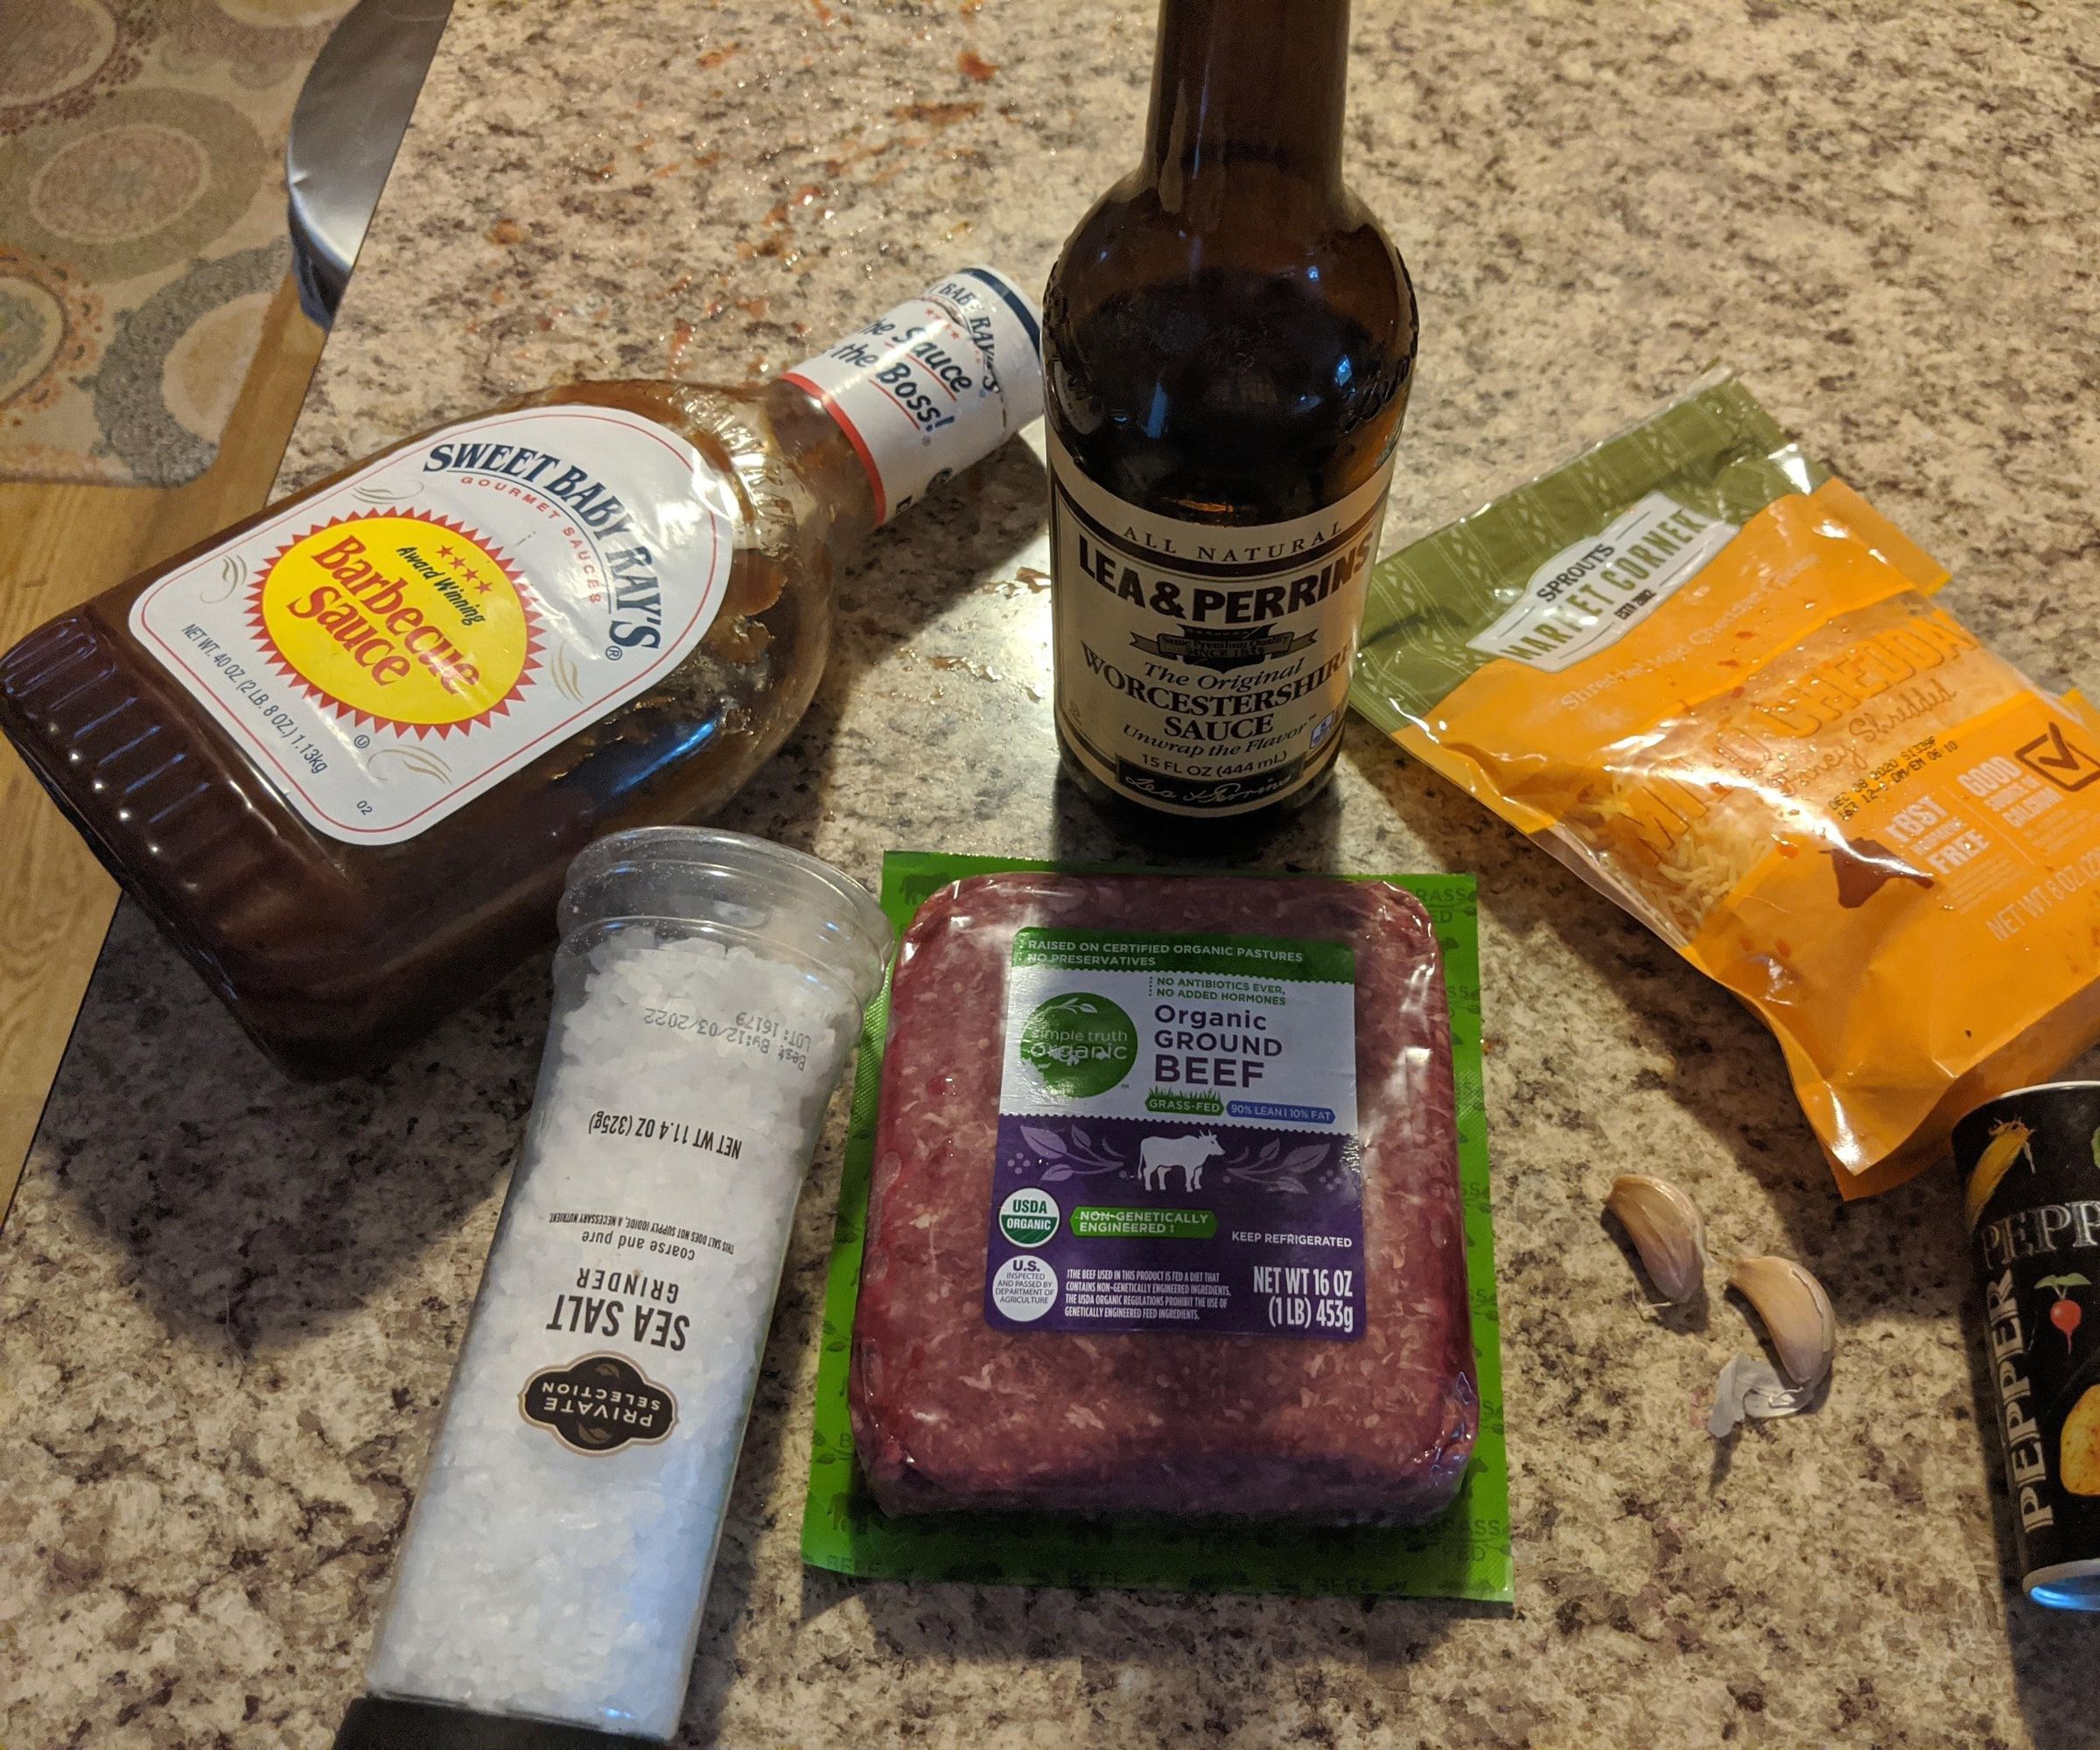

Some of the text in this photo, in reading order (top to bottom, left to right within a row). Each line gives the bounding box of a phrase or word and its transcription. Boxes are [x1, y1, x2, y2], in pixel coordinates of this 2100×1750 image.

[832, 343, 878, 368] the
[892, 326, 972, 393] Sauce
[424, 443, 662, 649] SWEET BABY RAY'S
[460, 476, 602, 604] GOURMET SAUCES
[1124, 521, 1341, 562] ALL NATURAL
[1600, 509, 1709, 592] CORNER
[1536, 542, 1614, 602] SPROUTS
[396, 546, 486, 626] Award Winning
[311, 535, 480, 695] Barbecue
[287, 586, 411, 688] Sauce
[1144, 658, 1306, 693] The Original
[181, 623, 328, 774] NET WT. 40 OZ. (2 LB. 8 OZ.) 1.13kg
[1848, 678, 1957, 743] Shredded
[1123, 723, 1204, 758] Unwrap
[1208, 743, 1240, 757] the
[1245, 724, 1306, 752] Flavor
[1164, 713, 1275, 742] SAUCE
[1141, 751, 1287, 778] 15 FL OZ (444 mL)
[1956, 756, 2023, 797] GOOD
[355, 799, 374, 816] 02
[1828, 792, 1850, 811] DEC
[1885, 795, 1948, 843] rBST
[1928, 830, 1992, 874] FREE
[1986, 903, 2026, 942] NET
[2017, 886, 2052, 919] WT
[1027, 954, 1156, 966] NO PRESERVATIVES
[1028, 940, 1303, 962] RAISED ON CERTIFIED ORGANIC PASTURES
[1157, 976, 1285, 995] NO ANTIBIOTICS EVER,
[1157, 988, 1286, 1005] NO ADDED HORMONES
[1154, 1004, 1267, 1031] Organic
[735, 1012, 812, 1053] LOT: 16179
[1031, 1029, 1128, 1044] simple truth
[1154, 1029, 1283, 1057] GROUND
[778, 1045, 807, 1072] Best
[1030, 1042, 1128, 1063] organic
[1155, 1054, 1265, 1088] BEEF
[1149, 1099, 1220, 1113] GRASS-FED
[1231, 1104, 1332, 1122] 90% LEAN 10% FAT
[588, 1110, 742, 1159] NET WT 11.4 OZ (325g)
[578, 1214, 617, 1226] NECESSARY
[1012, 1199, 1047, 1214] USDA
[1080, 1211, 1208, 1224] NON-GENETICALLY
[618, 1216, 624, 1227] A
[626, 1216, 649, 1231] IODIDE,
[650, 1222, 676, 1236] SUPPLY
[676, 1228, 690, 1241] NOT
[1006, 1217, 1052, 1230] ORGANIC
[1079, 1222, 1166, 1234] ENGINEERED
[582, 1230, 695, 1261] coarse and pure
[690, 1231, 707, 1245] DOES
[708, 1236, 722, 1250] SALT
[722, 1241, 735, 1255] THIS
[1232, 1231, 1353, 1248] KEEP REFRIGERATED
[1012, 1259, 1040, 1272] U.S.
[1082, 1269, 1096, 1279] BEEF
[1097, 1270, 1113, 1279] USED
[1114, 1270, 1121, 1280] IN
[1122, 1270, 1136, 1280] THIS
[1137, 1270, 1164, 1281] PRODUCT
[1165, 1271, 1172, 1281] IS
[1172, 1271, 1183, 1281] FED
[1184, 1271, 1189, 1281] A
[1204, 1272, 1220, 1283] THAT
[577, 1268, 679, 1304] GRINDER
[995, 1288, 1045, 1297] DEPARTMENT
[1043, 1280, 1053, 1289] BY
[1066, 1281, 1096, 1292] CONTAINS
[1096, 1282, 1152, 1293] NON-GENETICALLY
[1152, 1283, 1190, 1294] ENGINEERED
[1253, 1265, 1354, 1297] NET WT 16 OZ
[999, 1296, 1049, 1305] AGRICULTURE
[1064, 1306, 1200, 1320] GENETICALLY ENGINEERED FEED INGREDIENTS.
[1066, 1293, 1077, 1304] THE
[1077, 1294, 1095, 1305] USDA
[1095, 1294, 1122, 1305] ORGANIC
[1123, 1295, 1164, 1306] REGULATIONS
[1165, 1296, 1194, 1306] PROHIBIT
[1194, 1297, 1206, 1307] THE
[1207, 1298, 1218, 1308] USE
[546, 1294, 690, 1351] SEA SALT
[1268, 1295, 1354, 1334] (1 LB) 453g
[542, 1382, 661, 1410] SELECTION
[1985, 1267, 2055, 1534] PEPPER
[543, 1397, 653, 1427] PRIVATE
